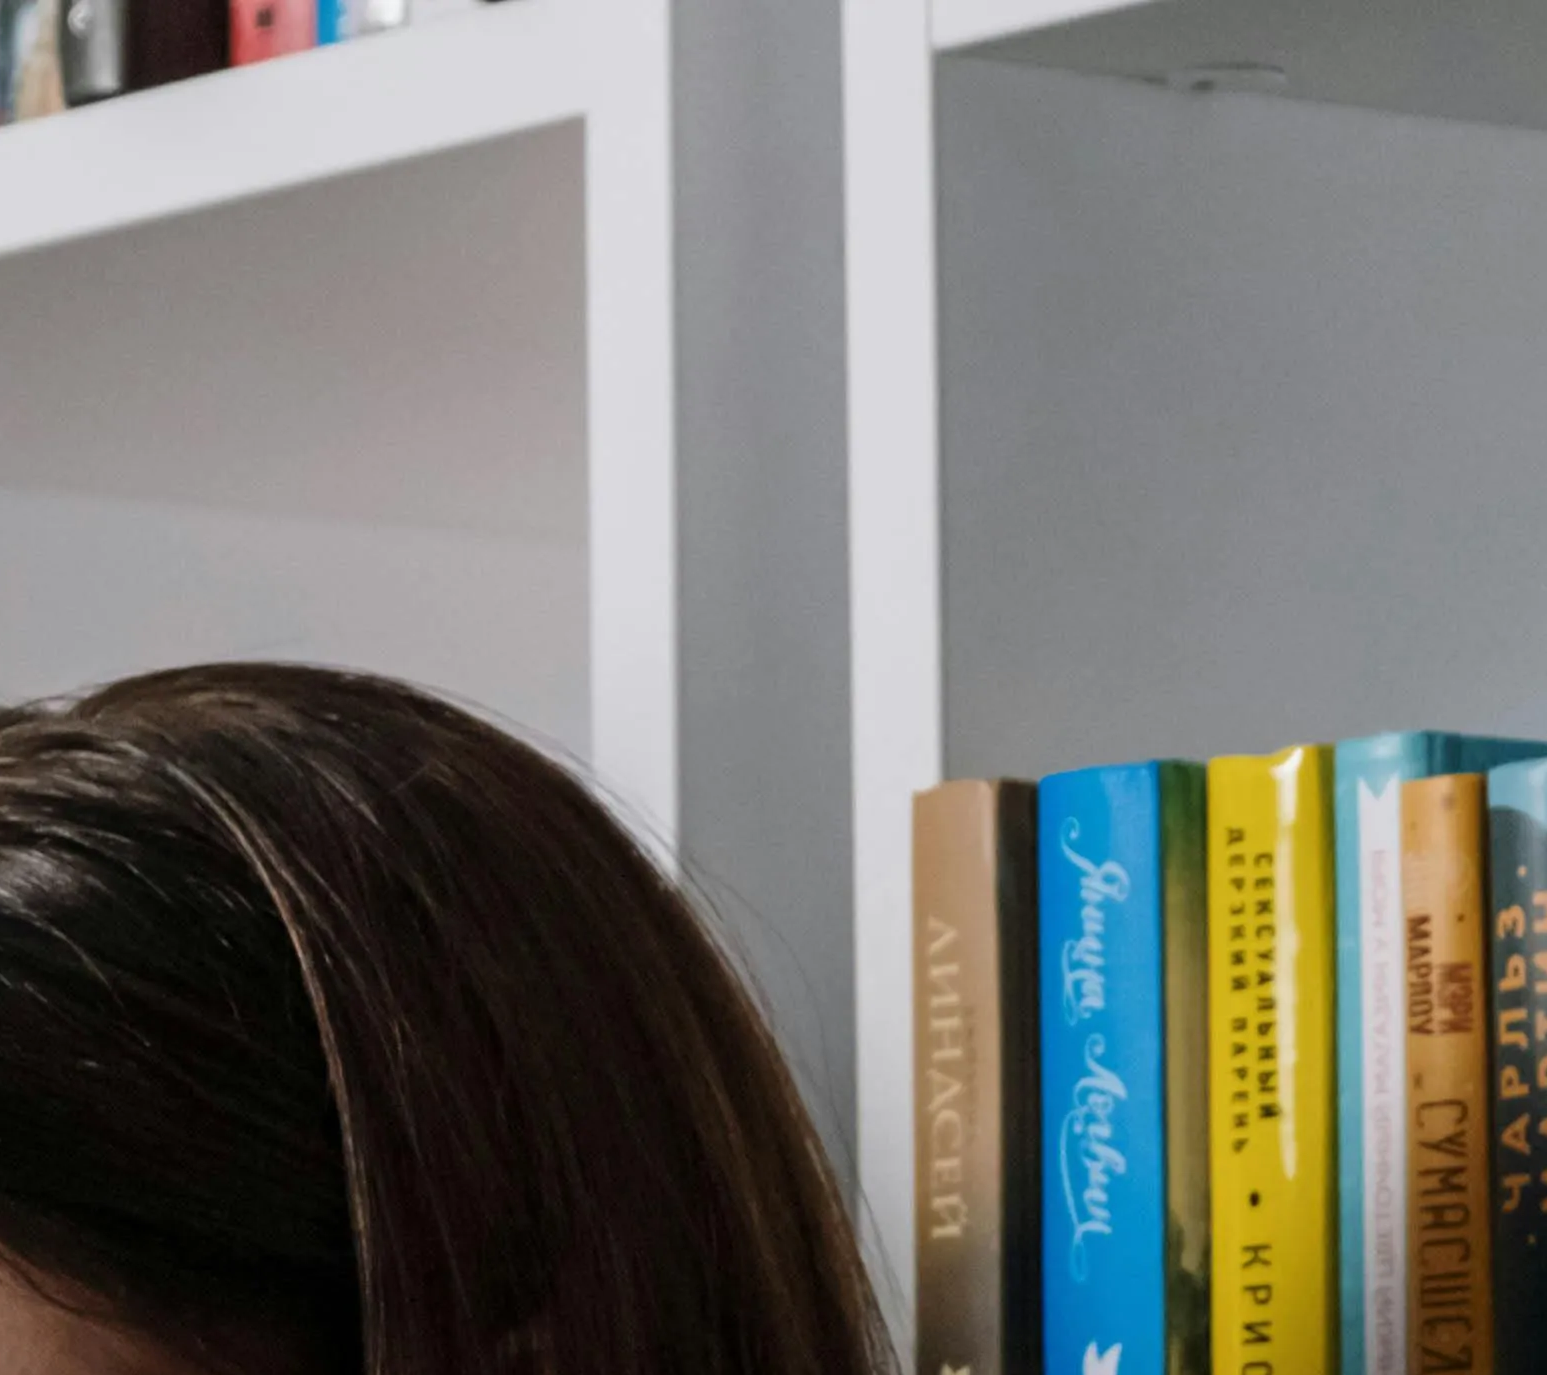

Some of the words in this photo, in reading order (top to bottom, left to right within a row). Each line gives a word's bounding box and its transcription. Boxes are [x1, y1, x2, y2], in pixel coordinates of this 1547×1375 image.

[1060, 815, 1131, 1027] Янина
[1226, 826, 1250, 992] ДЕРЗКИЙ
[1252, 850, 1282, 1121] СЕКСУАЛЬНЫЙ
[1406, 913, 1434, 1036] МАРЛОУ
[927, 915, 970, 1240] ЛИНДСЕЙ
[1059, 1033, 1129, 1283] Логвин
[1229, 1016, 1251, 1154] ПАРЕНЬ
[1495, 904, 1532, 1214] ЧАРЛЬЗ
